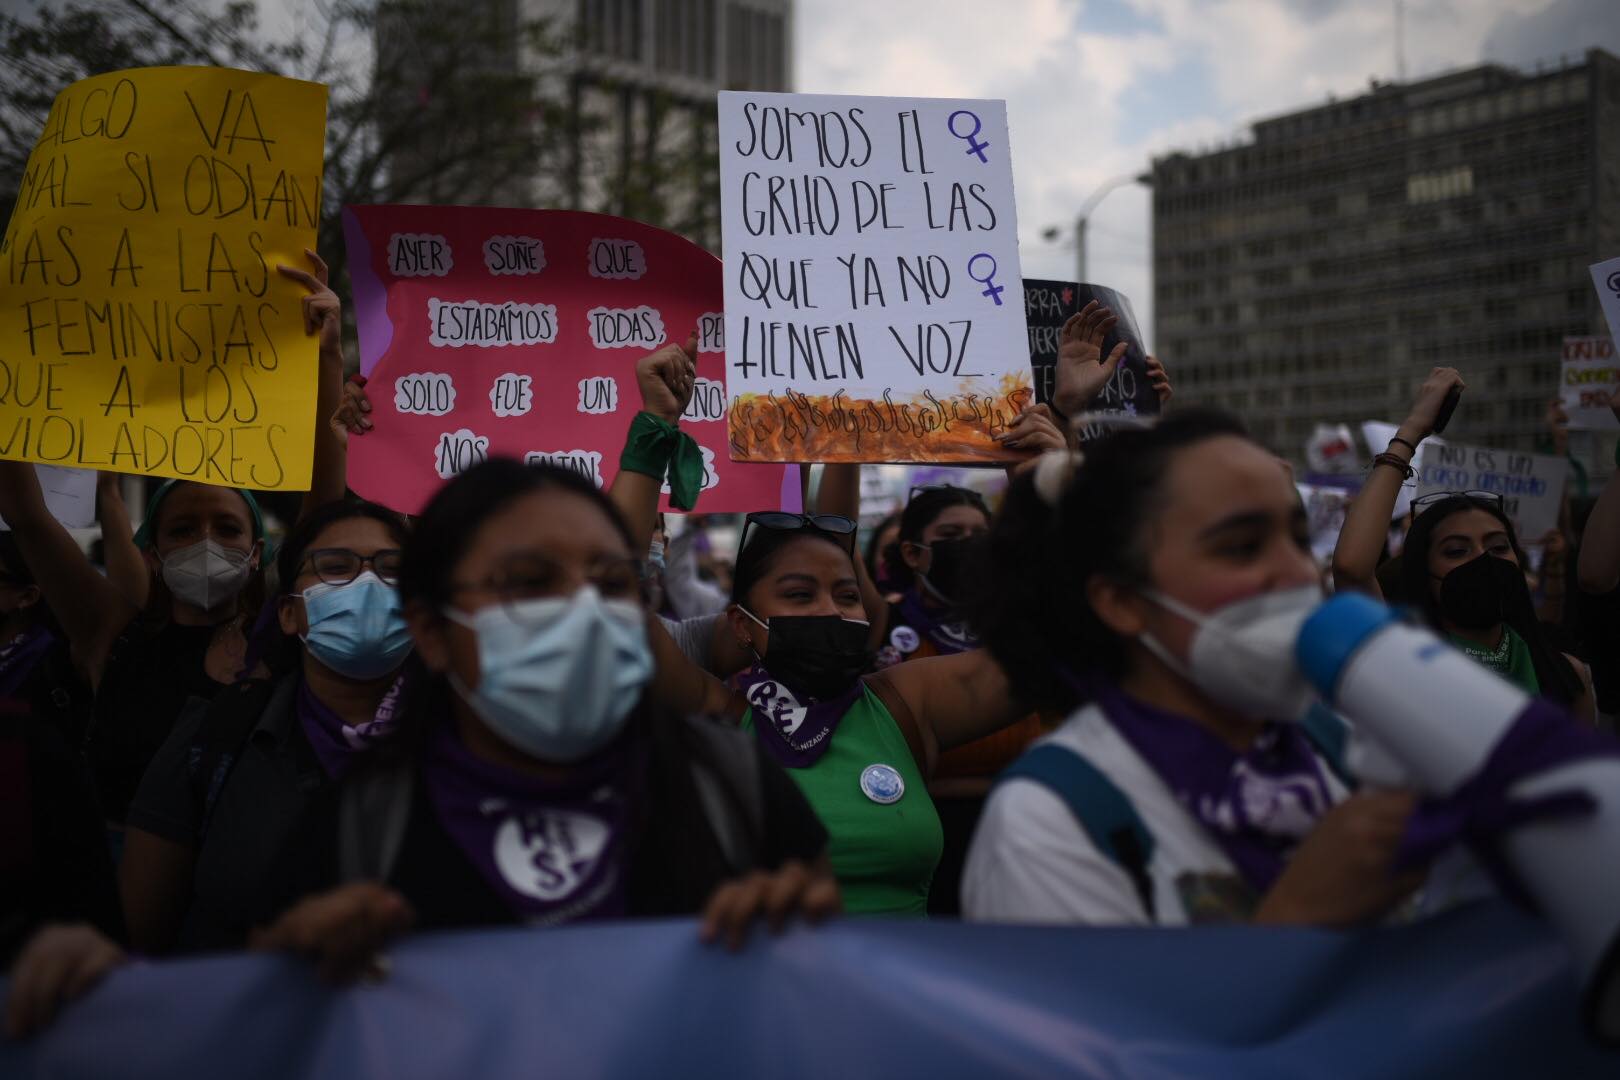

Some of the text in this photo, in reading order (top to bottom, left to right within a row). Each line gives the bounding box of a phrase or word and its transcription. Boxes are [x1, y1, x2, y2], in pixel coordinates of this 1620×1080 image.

[35, 79, 275, 161] ALGO VA
[736, 102, 934, 174] SOMOS EL
[24, 152, 320, 229] MAL SI ODIAN
[852, 180, 904, 233] DE
[923, 182, 996, 231] LAS
[108, 227, 143, 287] A
[178, 227, 268, 297] LAS
[394, 238, 443, 273] AYER
[594, 241, 637, 275] QUE
[740, 251, 951, 309] QUE YA NO
[593, 312, 664, 343] TODAS,
[702, 317, 725, 348] PE
[1025, 288, 1062, 317] RRA
[22, 297, 279, 371] FEMINISTAS
[99, 365, 141, 418] A
[179, 363, 258, 424] LOS
[399, 380, 449, 411] SOLO
[496, 380, 527, 410] FUE
[584, 380, 611, 410] UN
[0, 415, 286, 488] VIOLADORES
